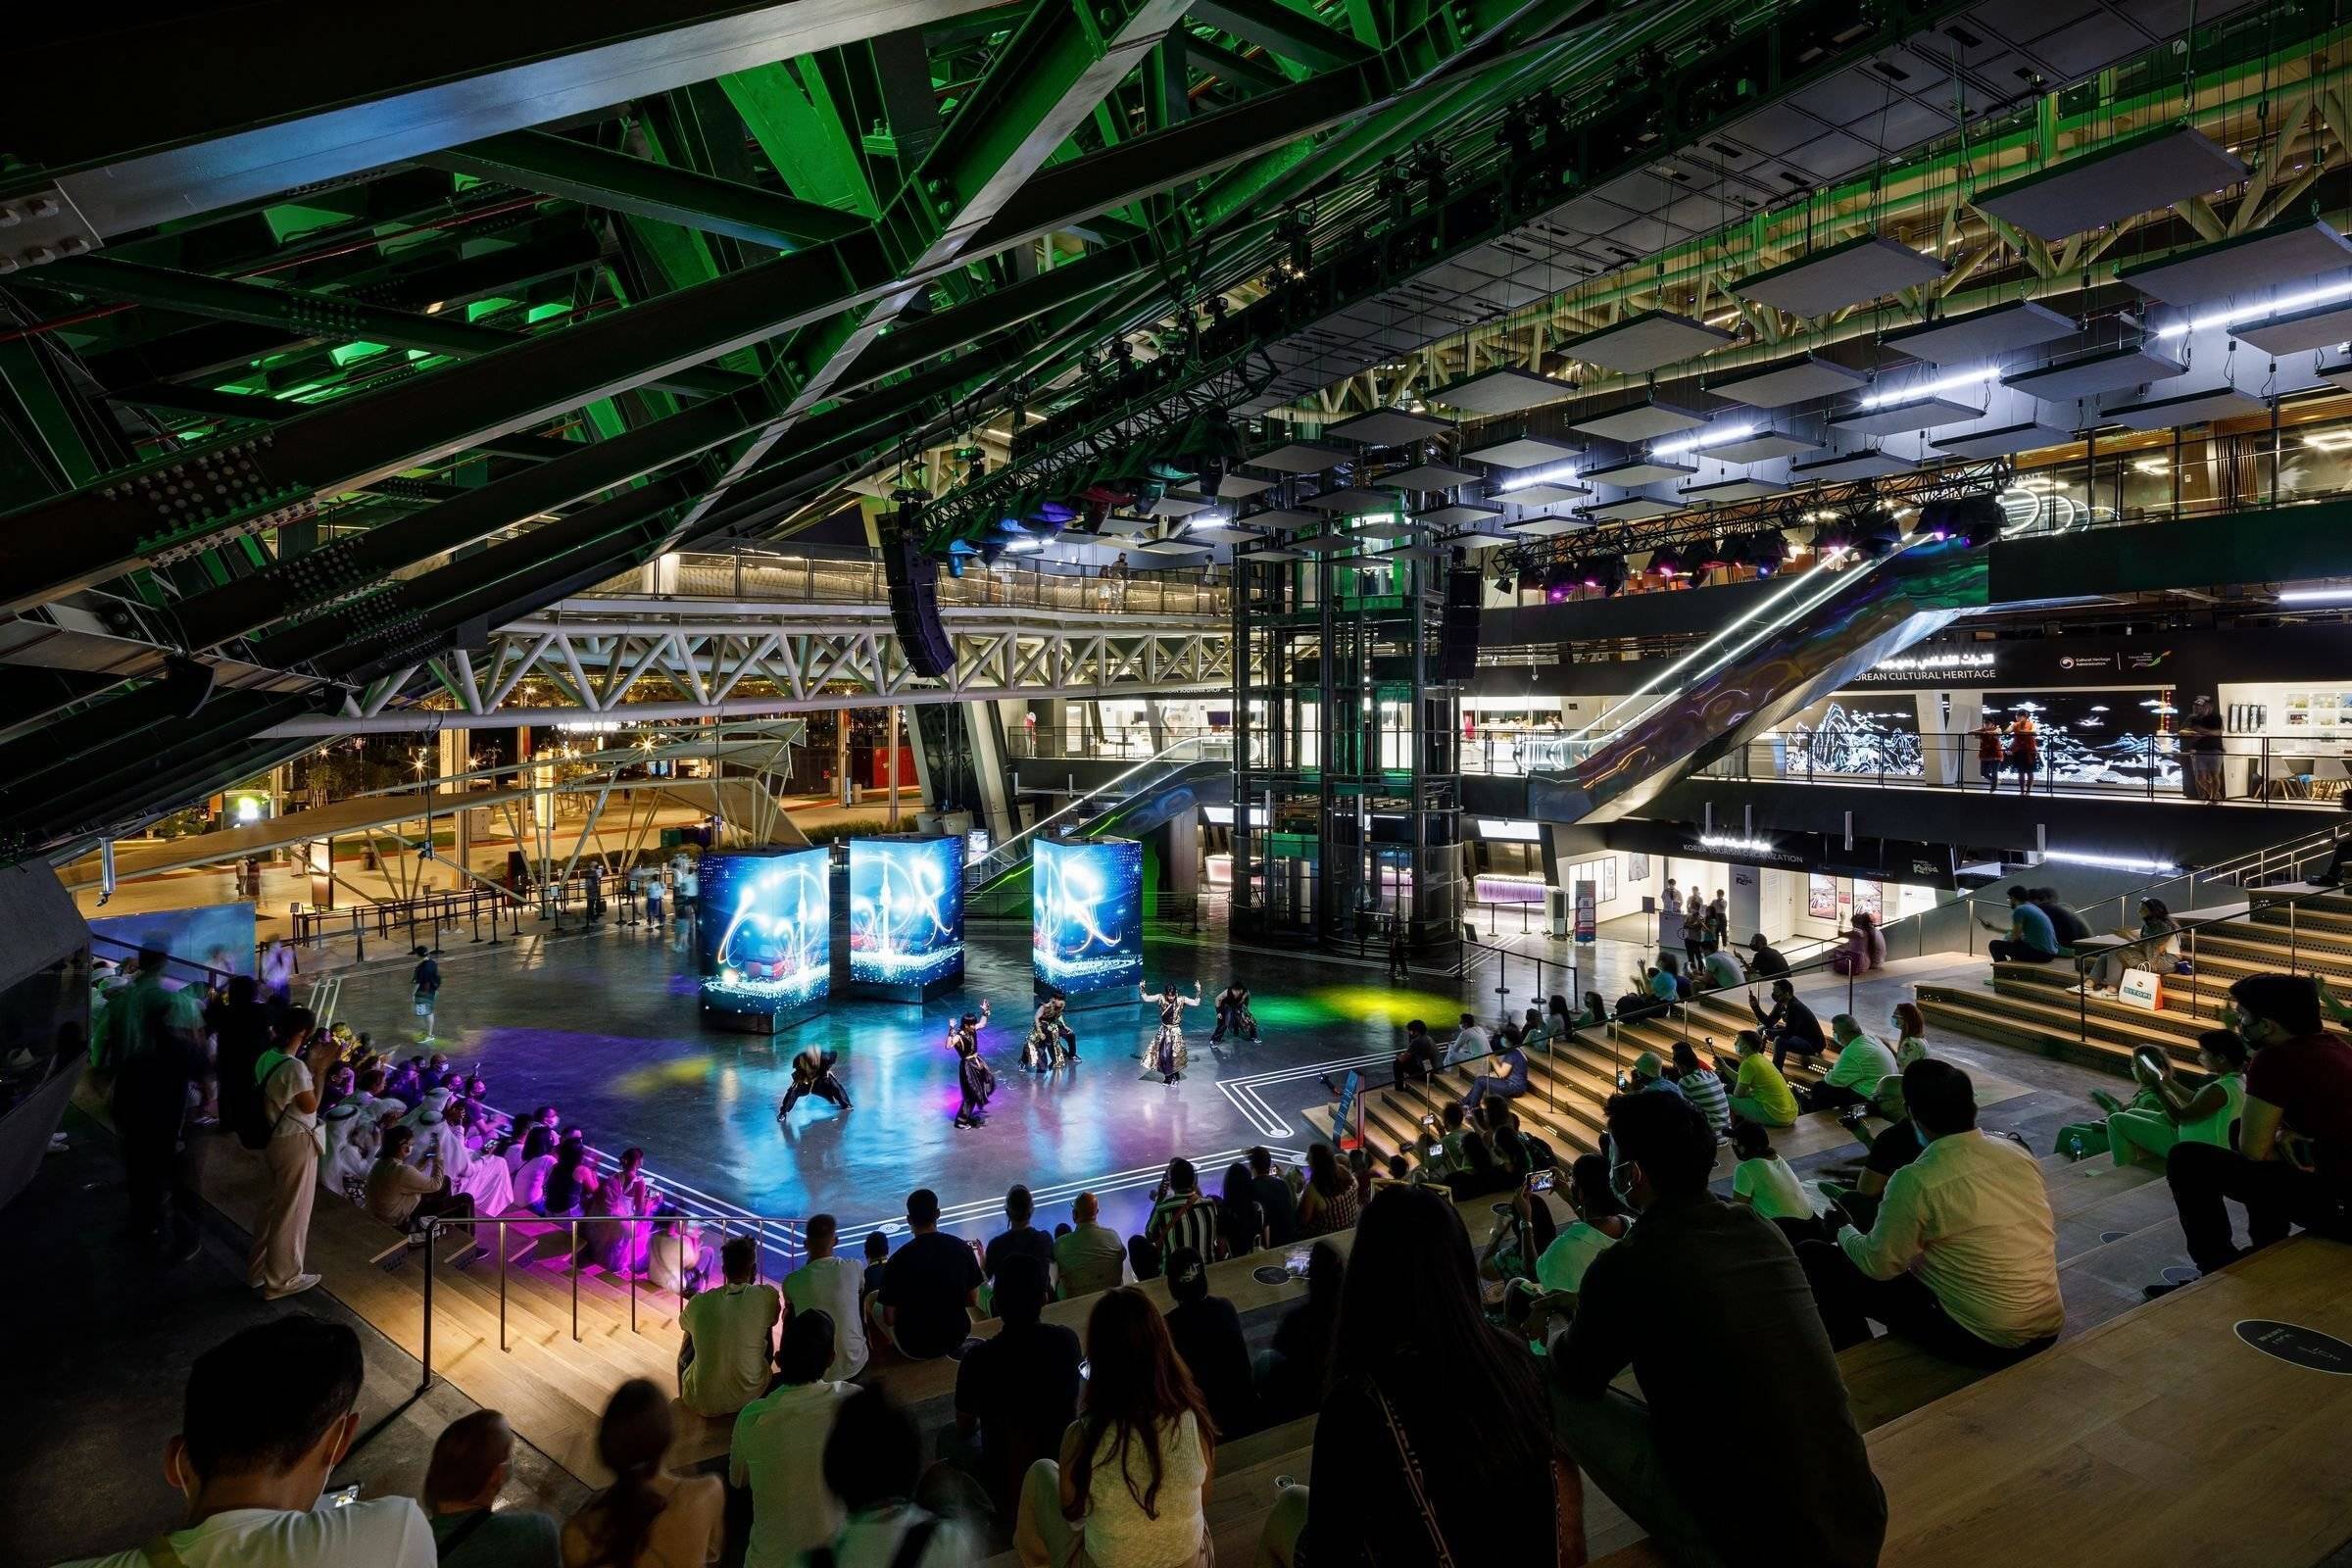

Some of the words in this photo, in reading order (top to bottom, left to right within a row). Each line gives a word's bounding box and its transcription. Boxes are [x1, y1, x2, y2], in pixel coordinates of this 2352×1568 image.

[1854, 672, 1887, 681] OREAN
[1889, 670, 1941, 681] CULTURAL
[1942, 669, 1996, 679] HERITAGE
[1683, 844, 1706, 853] KOREA
[1708, 846, 1741, 856] TOURISM
[1744, 850, 1803, 862] ORGANIZATION
